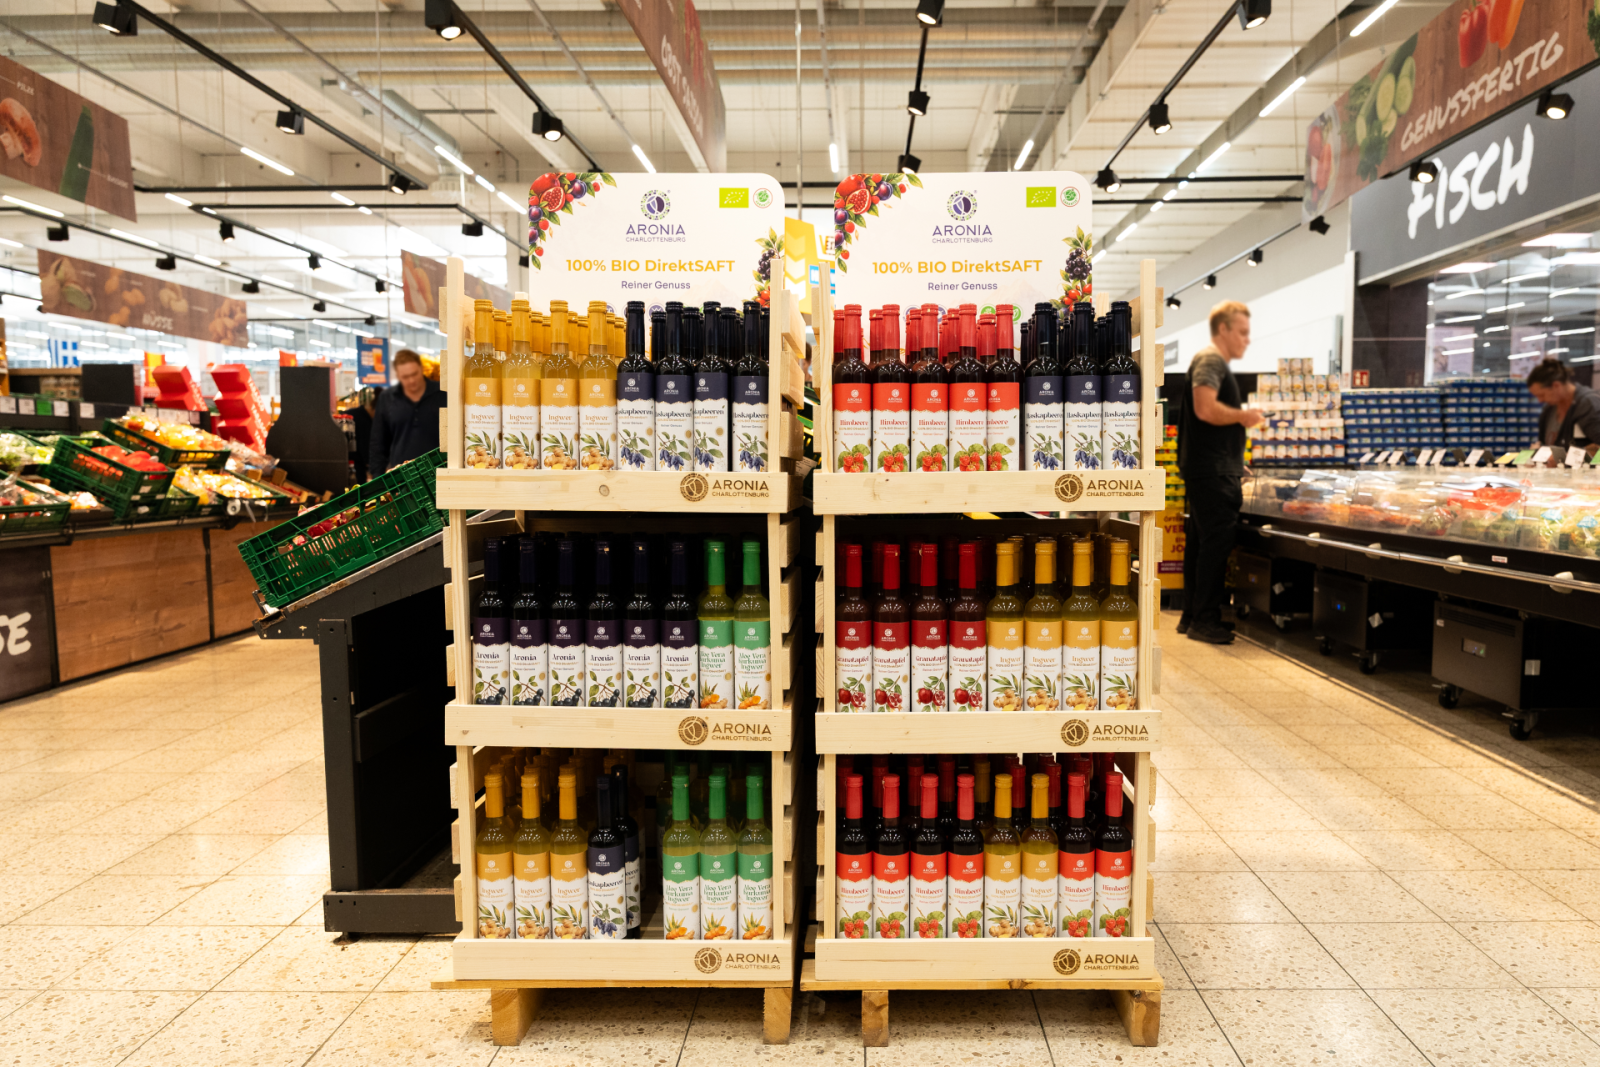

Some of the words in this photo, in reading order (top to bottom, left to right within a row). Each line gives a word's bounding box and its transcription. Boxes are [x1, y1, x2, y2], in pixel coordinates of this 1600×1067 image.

[16, 81, 35, 96] PILZE
[1399, 30, 1565, 152] GENUSSFERTIG
[1407, 123, 1535, 240] FISCH
[626, 224, 685, 235] ARONIA
[932, 225, 992, 236] ARONIA
[566, 259, 606, 273] 100%
[611, 260, 640, 272] BIO
[645, 259, 735, 272] DirektSAFT
[872, 260, 913, 275] 100%
[918, 261, 946, 273] BIO
[952, 260, 1042, 272] DirektSAFT
[622, 281, 652, 289] Reiner
[655, 281, 690, 289] Genuss
[928, 282, 959, 291] Reiner
[961, 282, 997, 290] Genuss
[712, 480, 769, 490] ARONIA
[1087, 480, 1144, 490] ARONIA
[1170, 545, 1185, 553] JO
[0, 612, 32, 656] E
[712, 723, 771, 734] ARONIA
[1093, 725, 1148, 735] ARONIA
[955, 887, 982, 895] Himbeere
[726, 953, 780, 963] ARONIA
[1084, 954, 1139, 964] ARONIA
